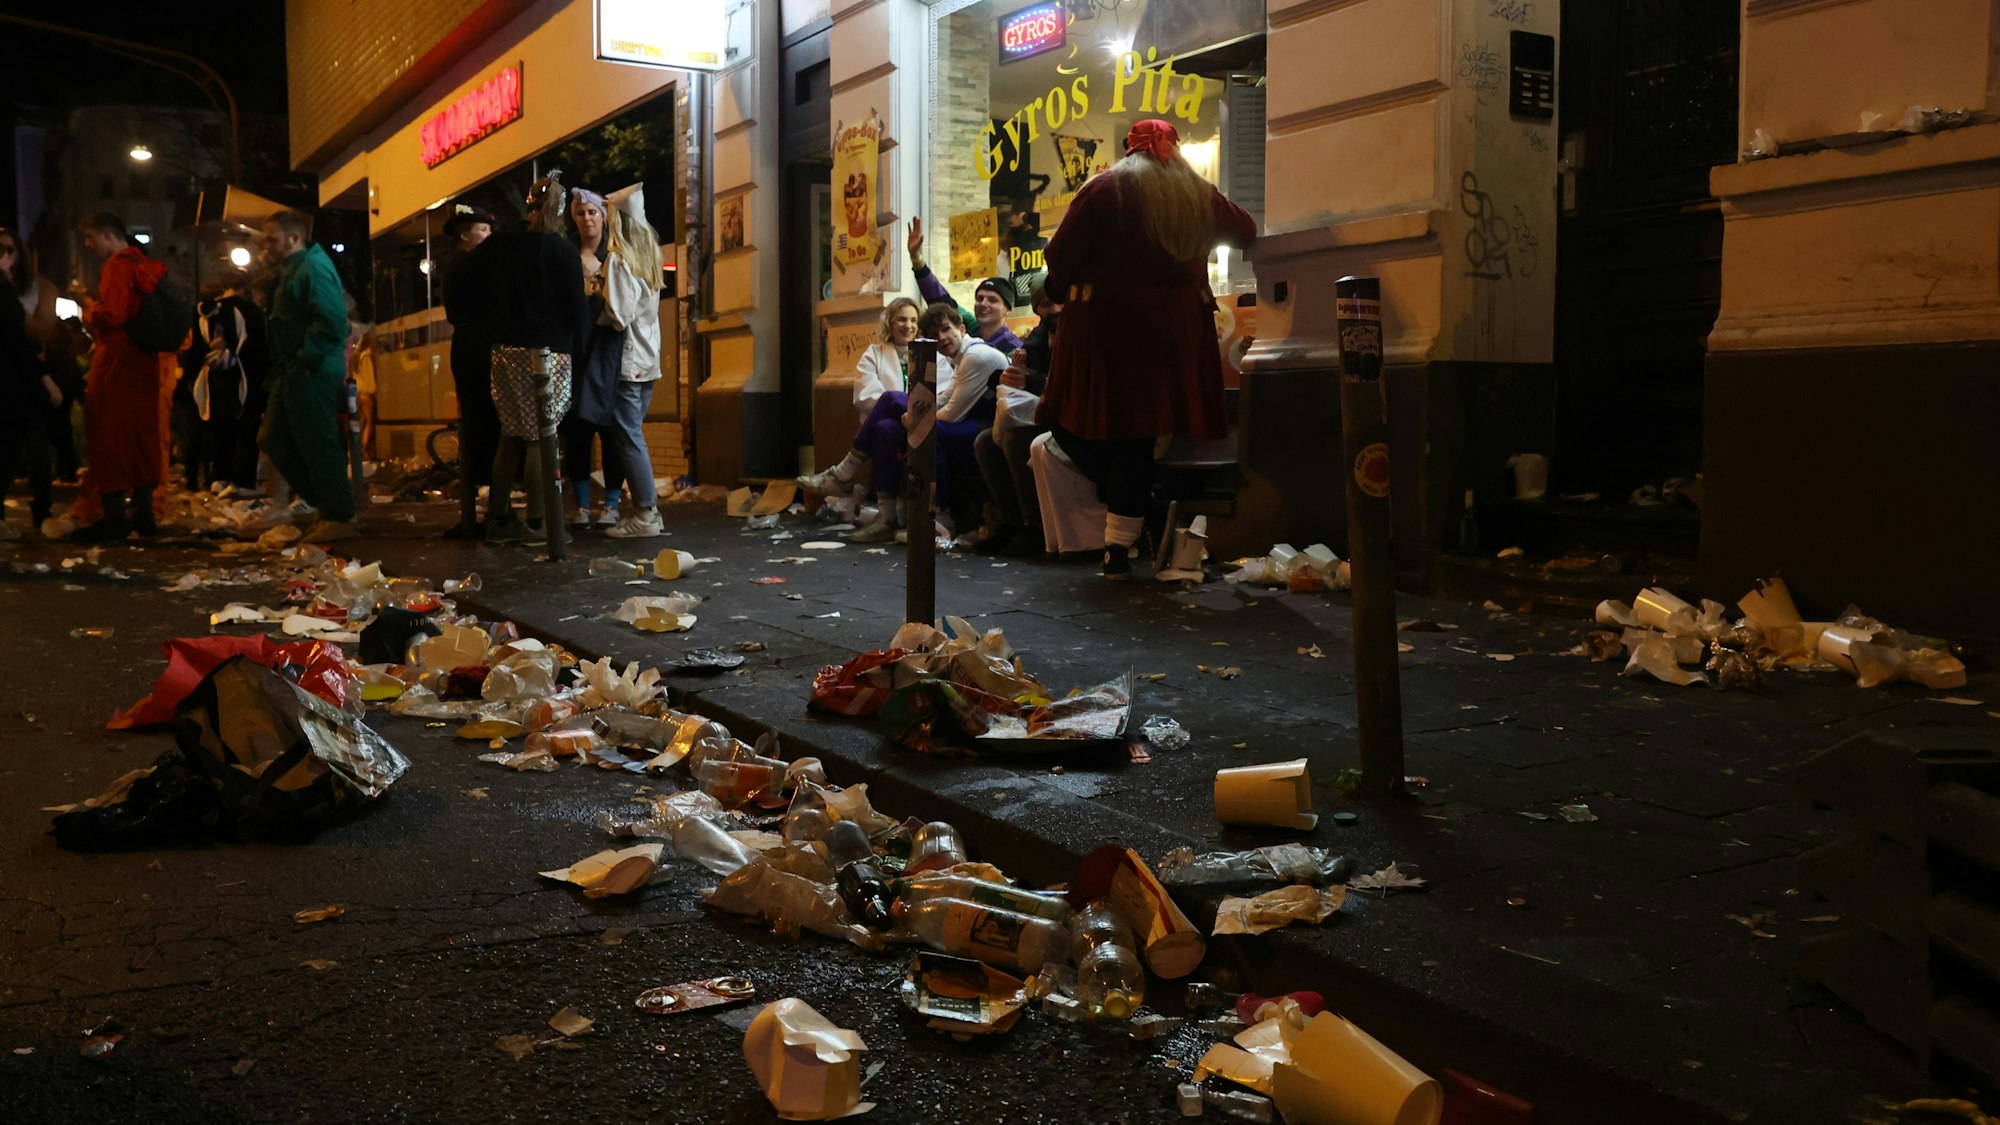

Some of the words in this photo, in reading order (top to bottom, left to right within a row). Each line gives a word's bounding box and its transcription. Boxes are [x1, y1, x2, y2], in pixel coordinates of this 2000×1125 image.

[1003, 13, 1057, 48] GYROS
[974, 74, 1089, 181] Gyros
[1109, 46, 1205, 125] Pita
[848, 248, 856, 259] To
[857, 245, 867, 256] Go
[1009, 246, 1047, 272] Pom
